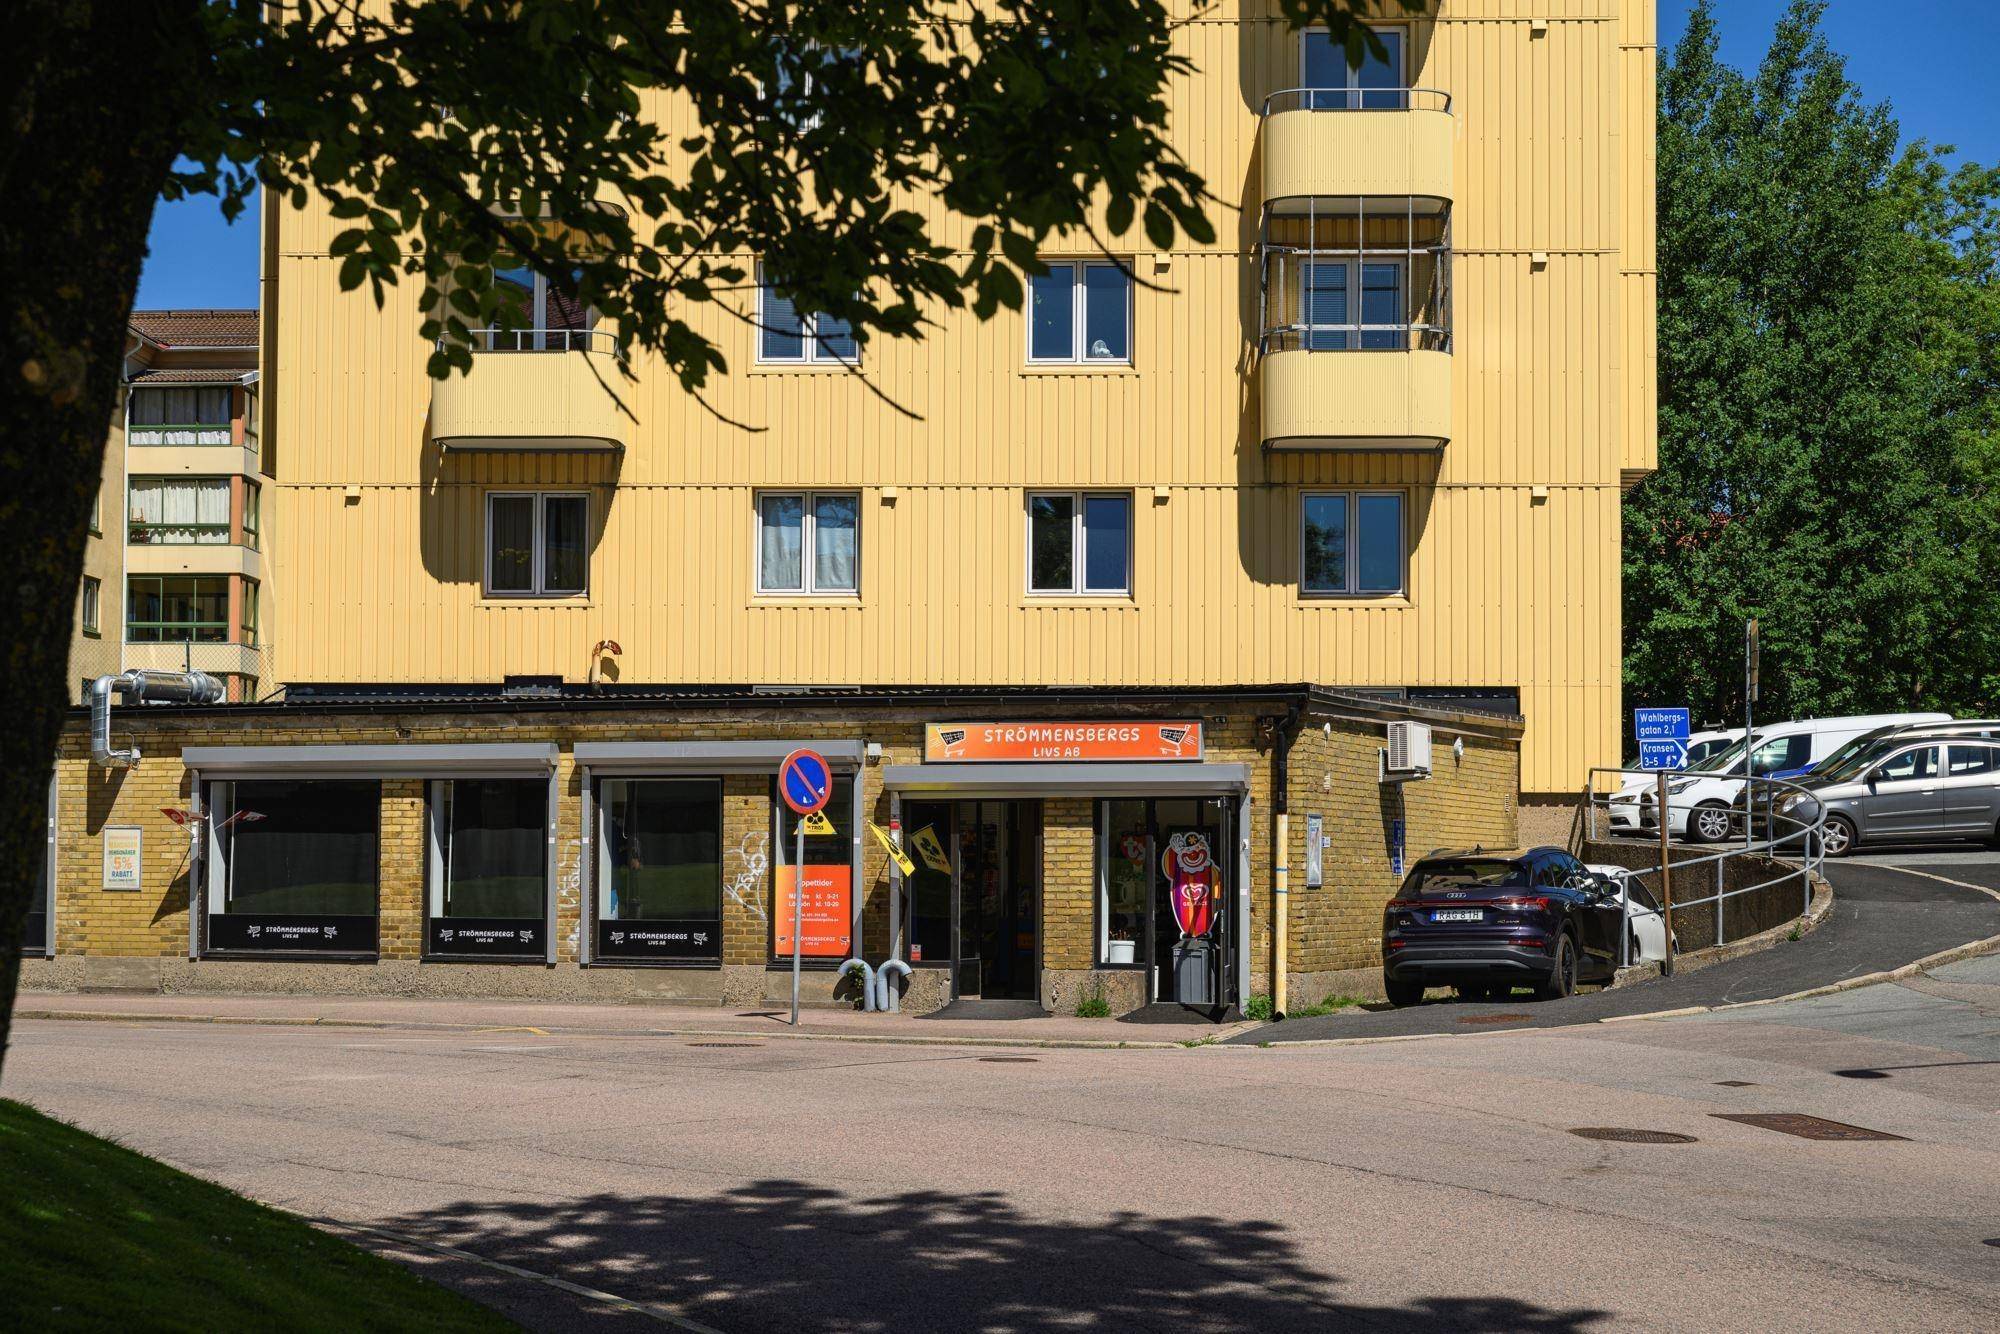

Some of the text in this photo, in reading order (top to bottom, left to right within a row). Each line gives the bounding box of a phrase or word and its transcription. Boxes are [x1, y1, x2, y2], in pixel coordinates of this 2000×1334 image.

[1640, 713, 1685, 724] Wahlbergs-
[984, 727, 1140, 742] STRÖMMENSBERGS
[1640, 725, 1675, 737] gatan 2,1
[1033, 747, 1080, 758] LIVS AB
[1643, 744, 1675, 753] Kransen
[1644, 757, 1659, 766] 3-5
[795, 880, 833, 888] ppettider
[1439, 909, 1479, 919] RAG 81H
[629, 932, 688, 940] STRÖMMENSBERGS
